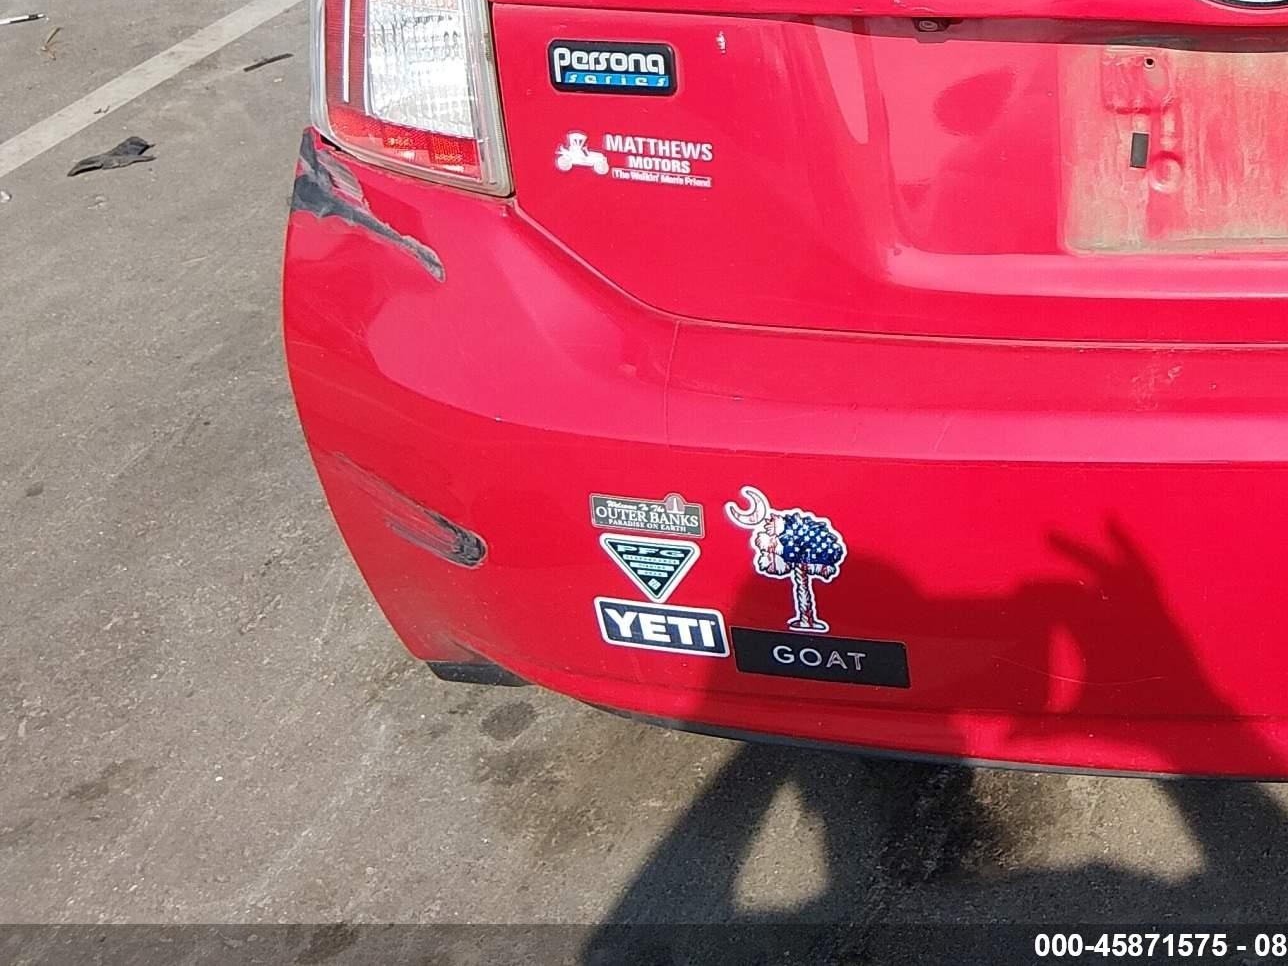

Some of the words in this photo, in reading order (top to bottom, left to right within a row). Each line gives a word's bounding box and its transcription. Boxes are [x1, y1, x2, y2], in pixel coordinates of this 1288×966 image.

[568, 72, 667, 87] series
[605, 134, 713, 161] MATTHEWS
[614, 169, 630, 179] The
[628, 155, 691, 174] MOTORS
[596, 506, 648, 523] OUTER
[650, 512, 699, 528] BANKS
[608, 519, 645, 529] PARADISE
[661, 524, 686, 532] EARTH
[616, 544, 685, 558] PFG
[603, 608, 716, 647] YETI
[773, 645, 866, 671] GOAT
